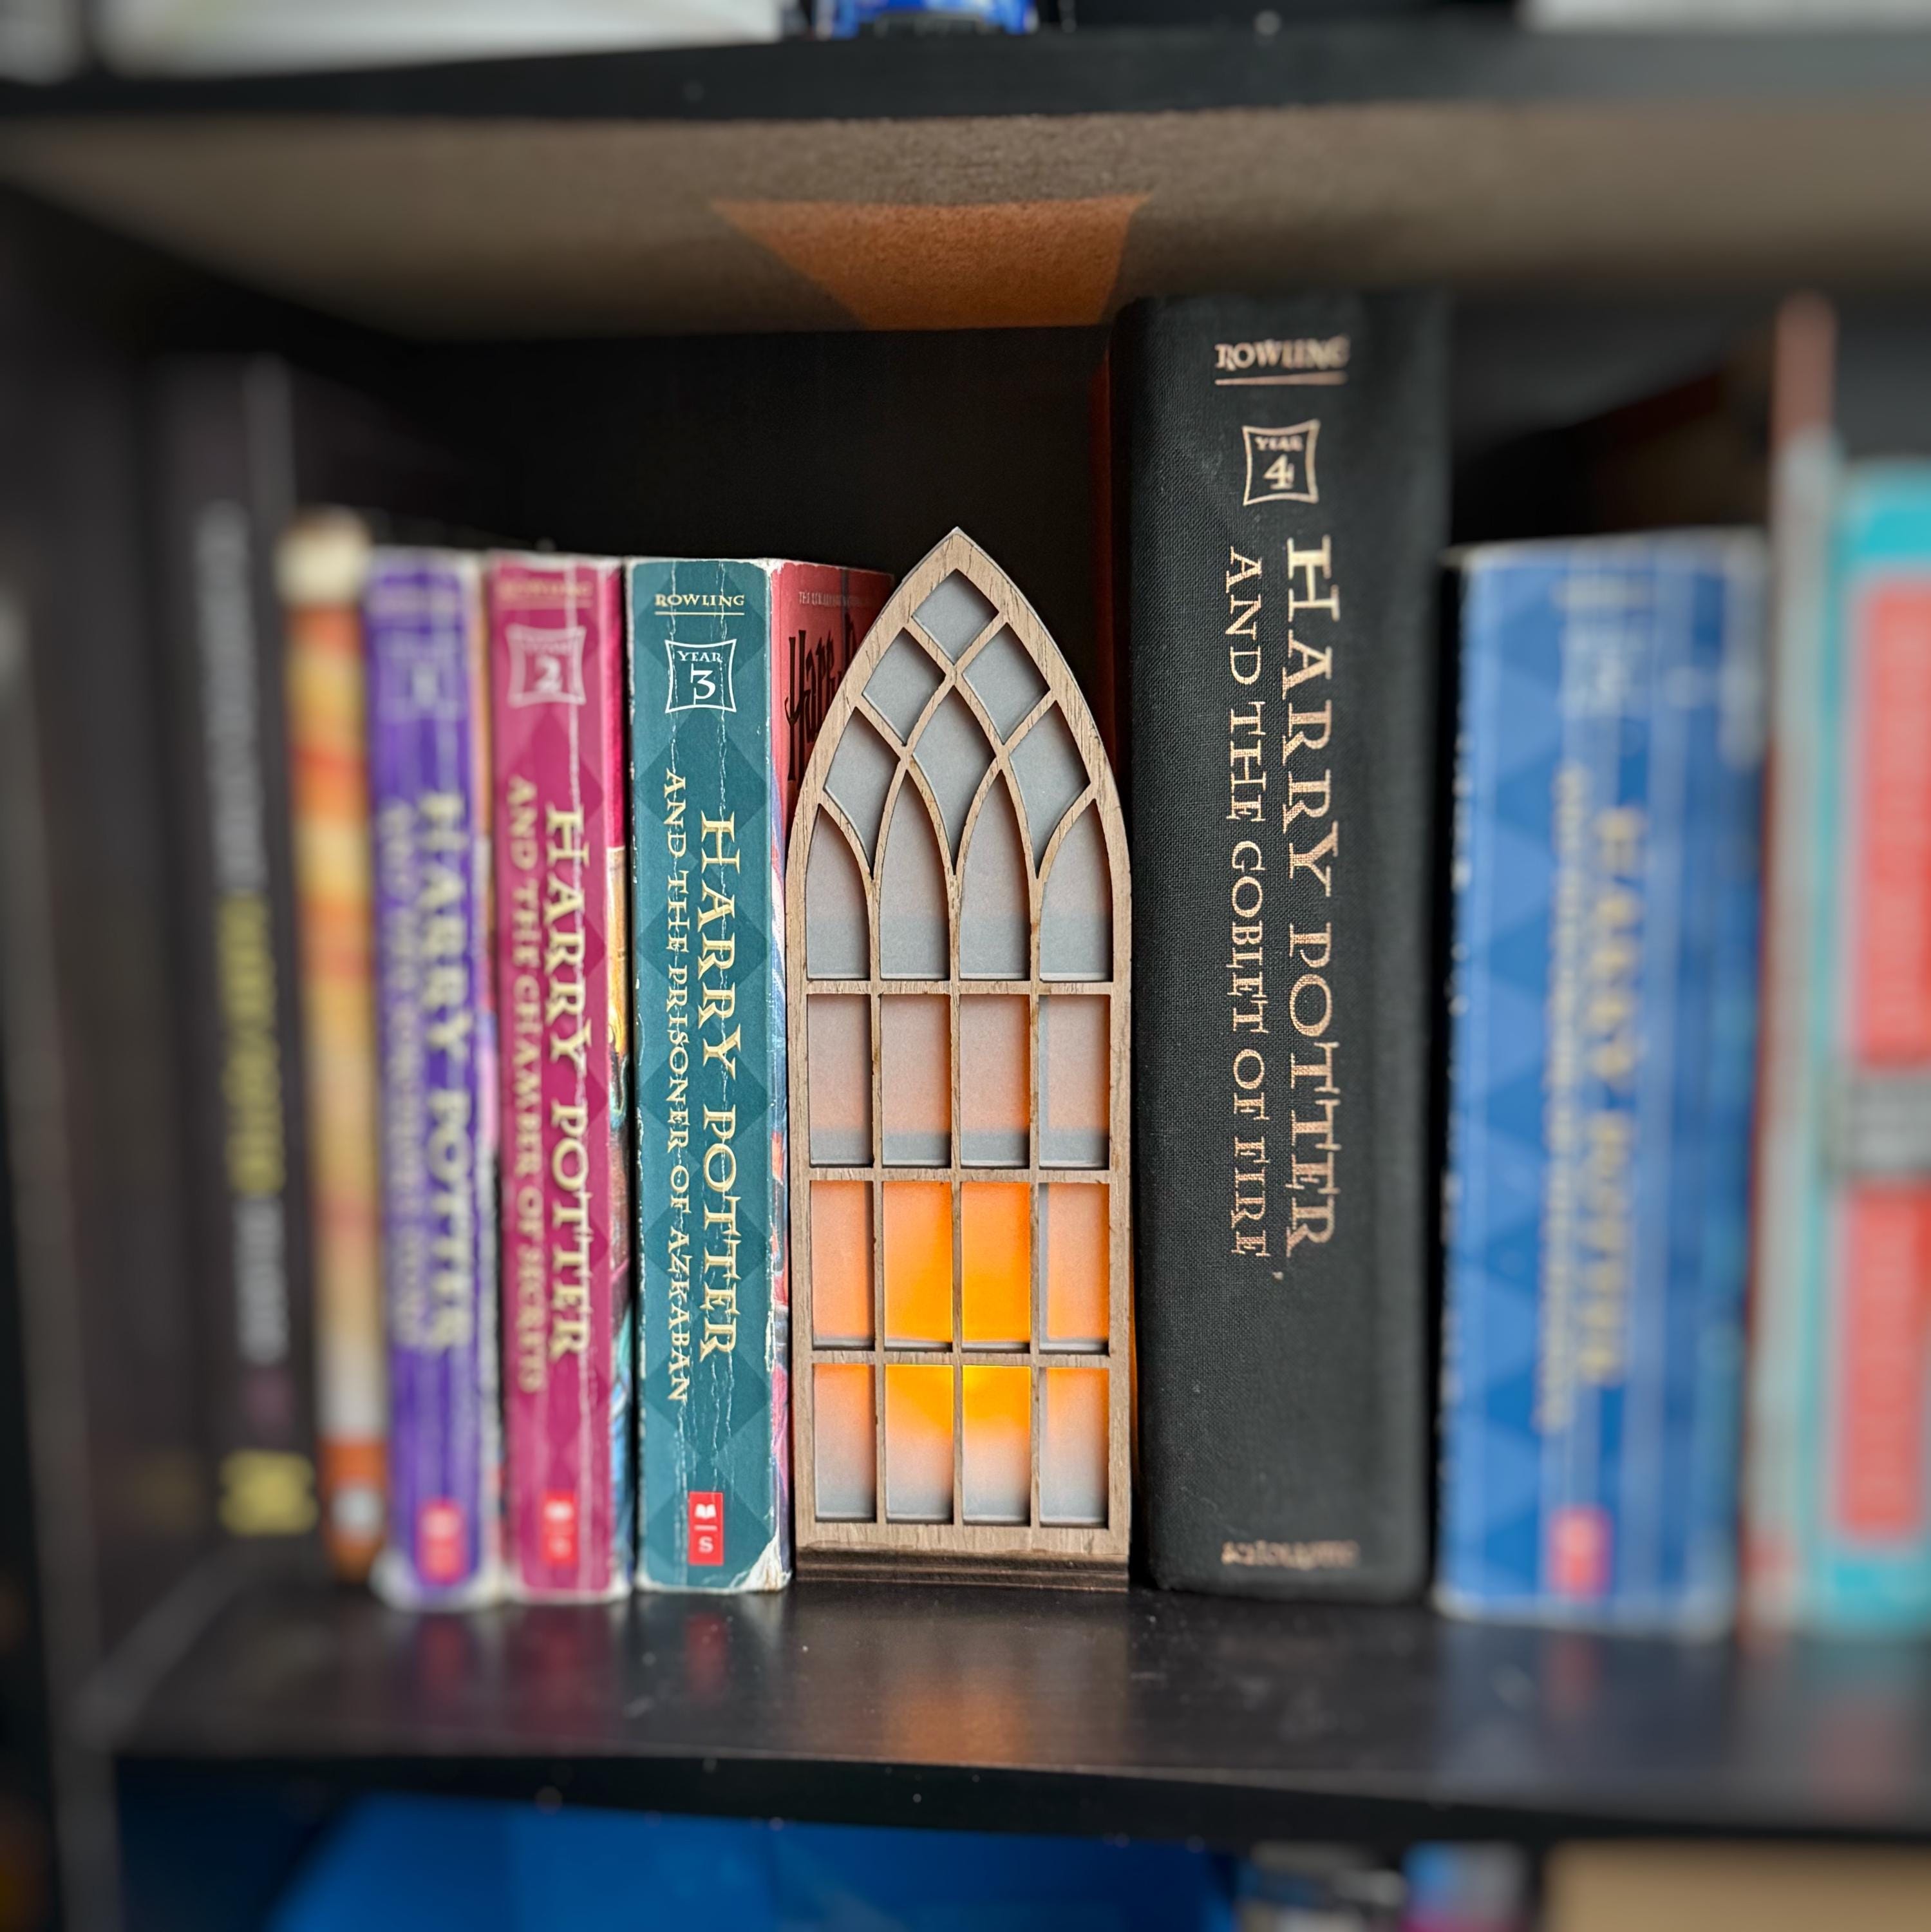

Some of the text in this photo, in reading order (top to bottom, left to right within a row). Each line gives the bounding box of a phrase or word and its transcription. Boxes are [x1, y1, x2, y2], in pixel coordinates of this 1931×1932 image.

[1214, 335, 1350, 369] ROWLING
[1255, 436, 1303, 451] YEAR
[1263, 454, 1295, 489] 4
[654, 593, 745, 607] ROWLING
[536, 654, 563, 694] 2
[677, 650, 723, 663] YEAR
[690, 663, 716, 705] 3
[507, 775, 538, 871] AND
[512, 878, 542, 967] THE
[1225, 545, 1271, 1257] AND THE GOBLET OF FIRE
[1282, 535, 1342, 1258] HARRY POTTER
[513, 975, 543, 1179] CHAMBER
[543, 801, 594, 1364] HARRY POTTER
[664, 768, 692, 1402] AND THE PRISONER OF AZKABAN
[697, 810, 741, 1363] HARRY POTTER
[516, 1186, 545, 1242] OF
[699, 1537, 714, 1553] S
